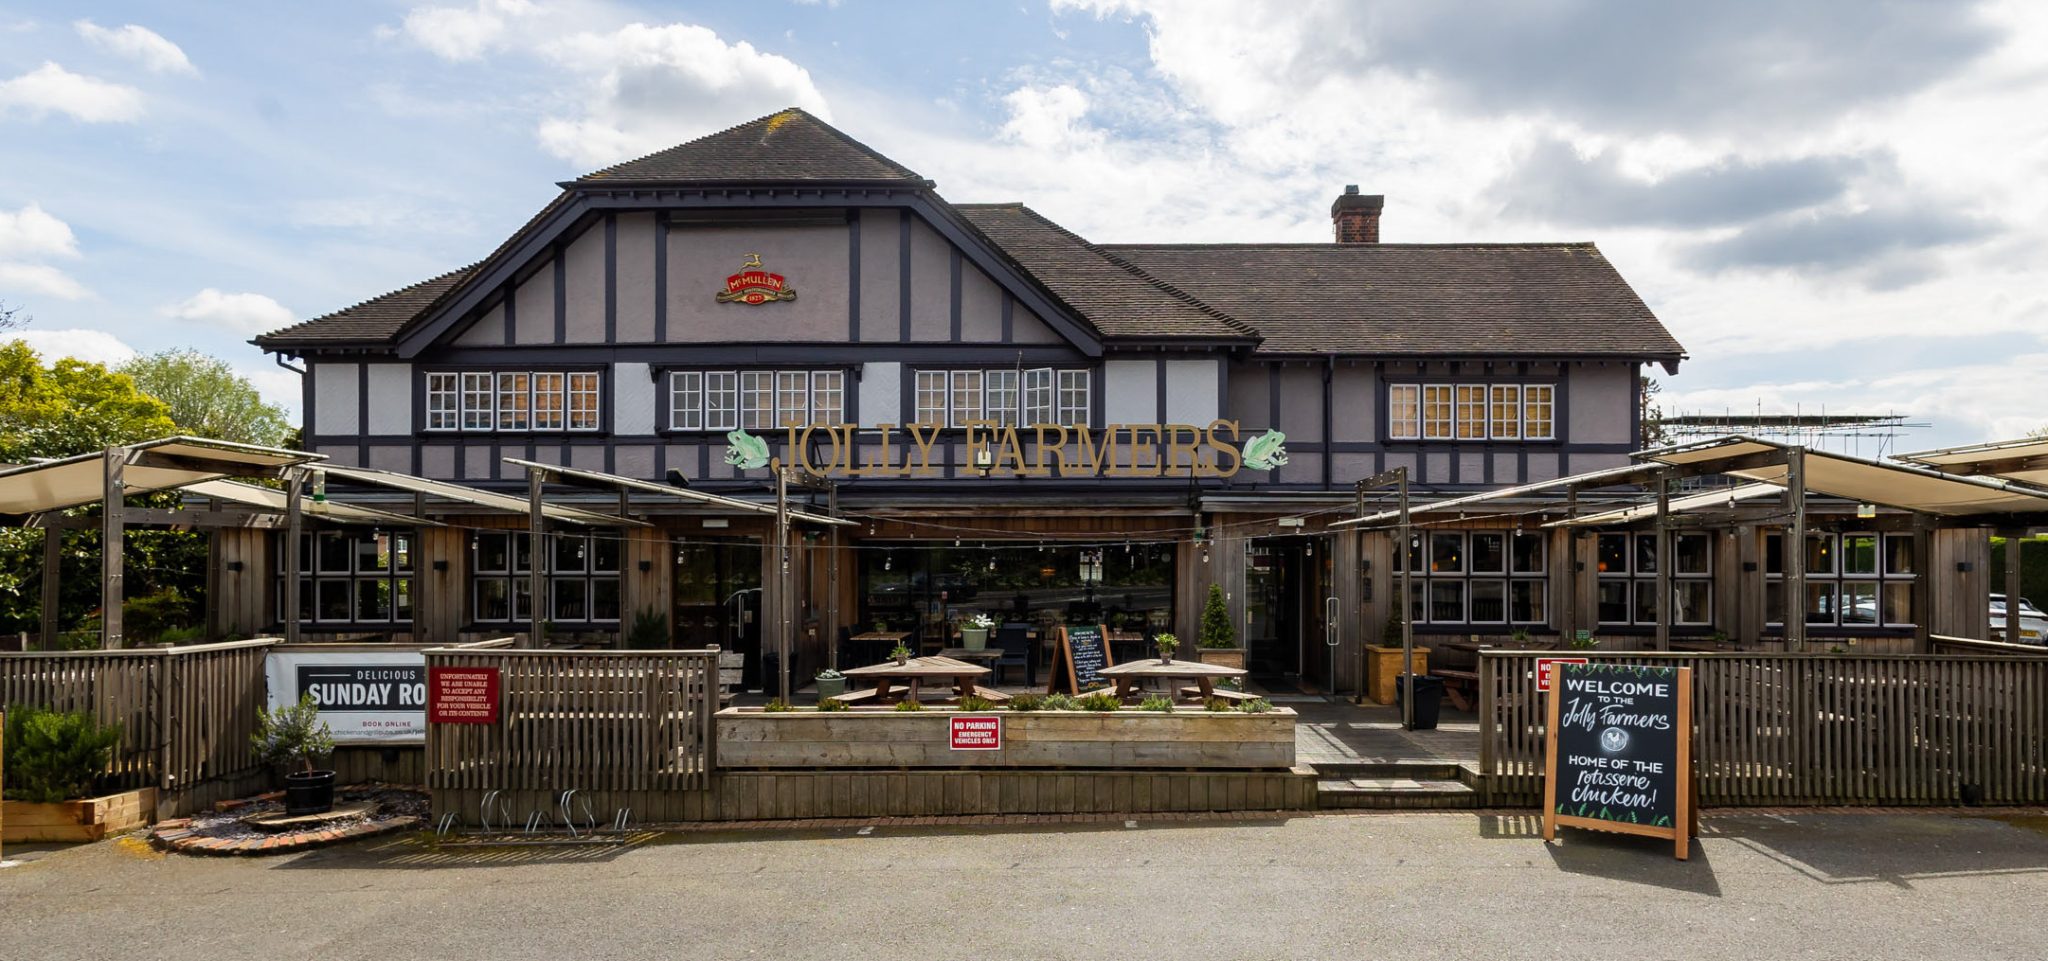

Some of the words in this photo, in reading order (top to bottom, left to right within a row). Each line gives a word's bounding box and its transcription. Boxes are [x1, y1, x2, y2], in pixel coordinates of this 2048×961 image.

[770, 420, 944, 477] JOLLY
[959, 418, 1240, 478] FARMERS
[357, 670, 416, 680] DELICIOUS
[308, 683, 392, 705] SUNDAY
[1566, 679, 1669, 697] WELCOME
[1598, 695, 1611, 703] TO
[1613, 696, 1634, 705] THE
[1563, 697, 1597, 732] Jolly
[1599, 704, 1670, 730] Farmers
[1568, 755, 1607, 768] HOME
[1610, 759, 1630, 769] OF
[1632, 760, 1664, 774] THE
[1577, 769, 1651, 790] rotisserie
[1571, 784, 1657, 810] chicken!
